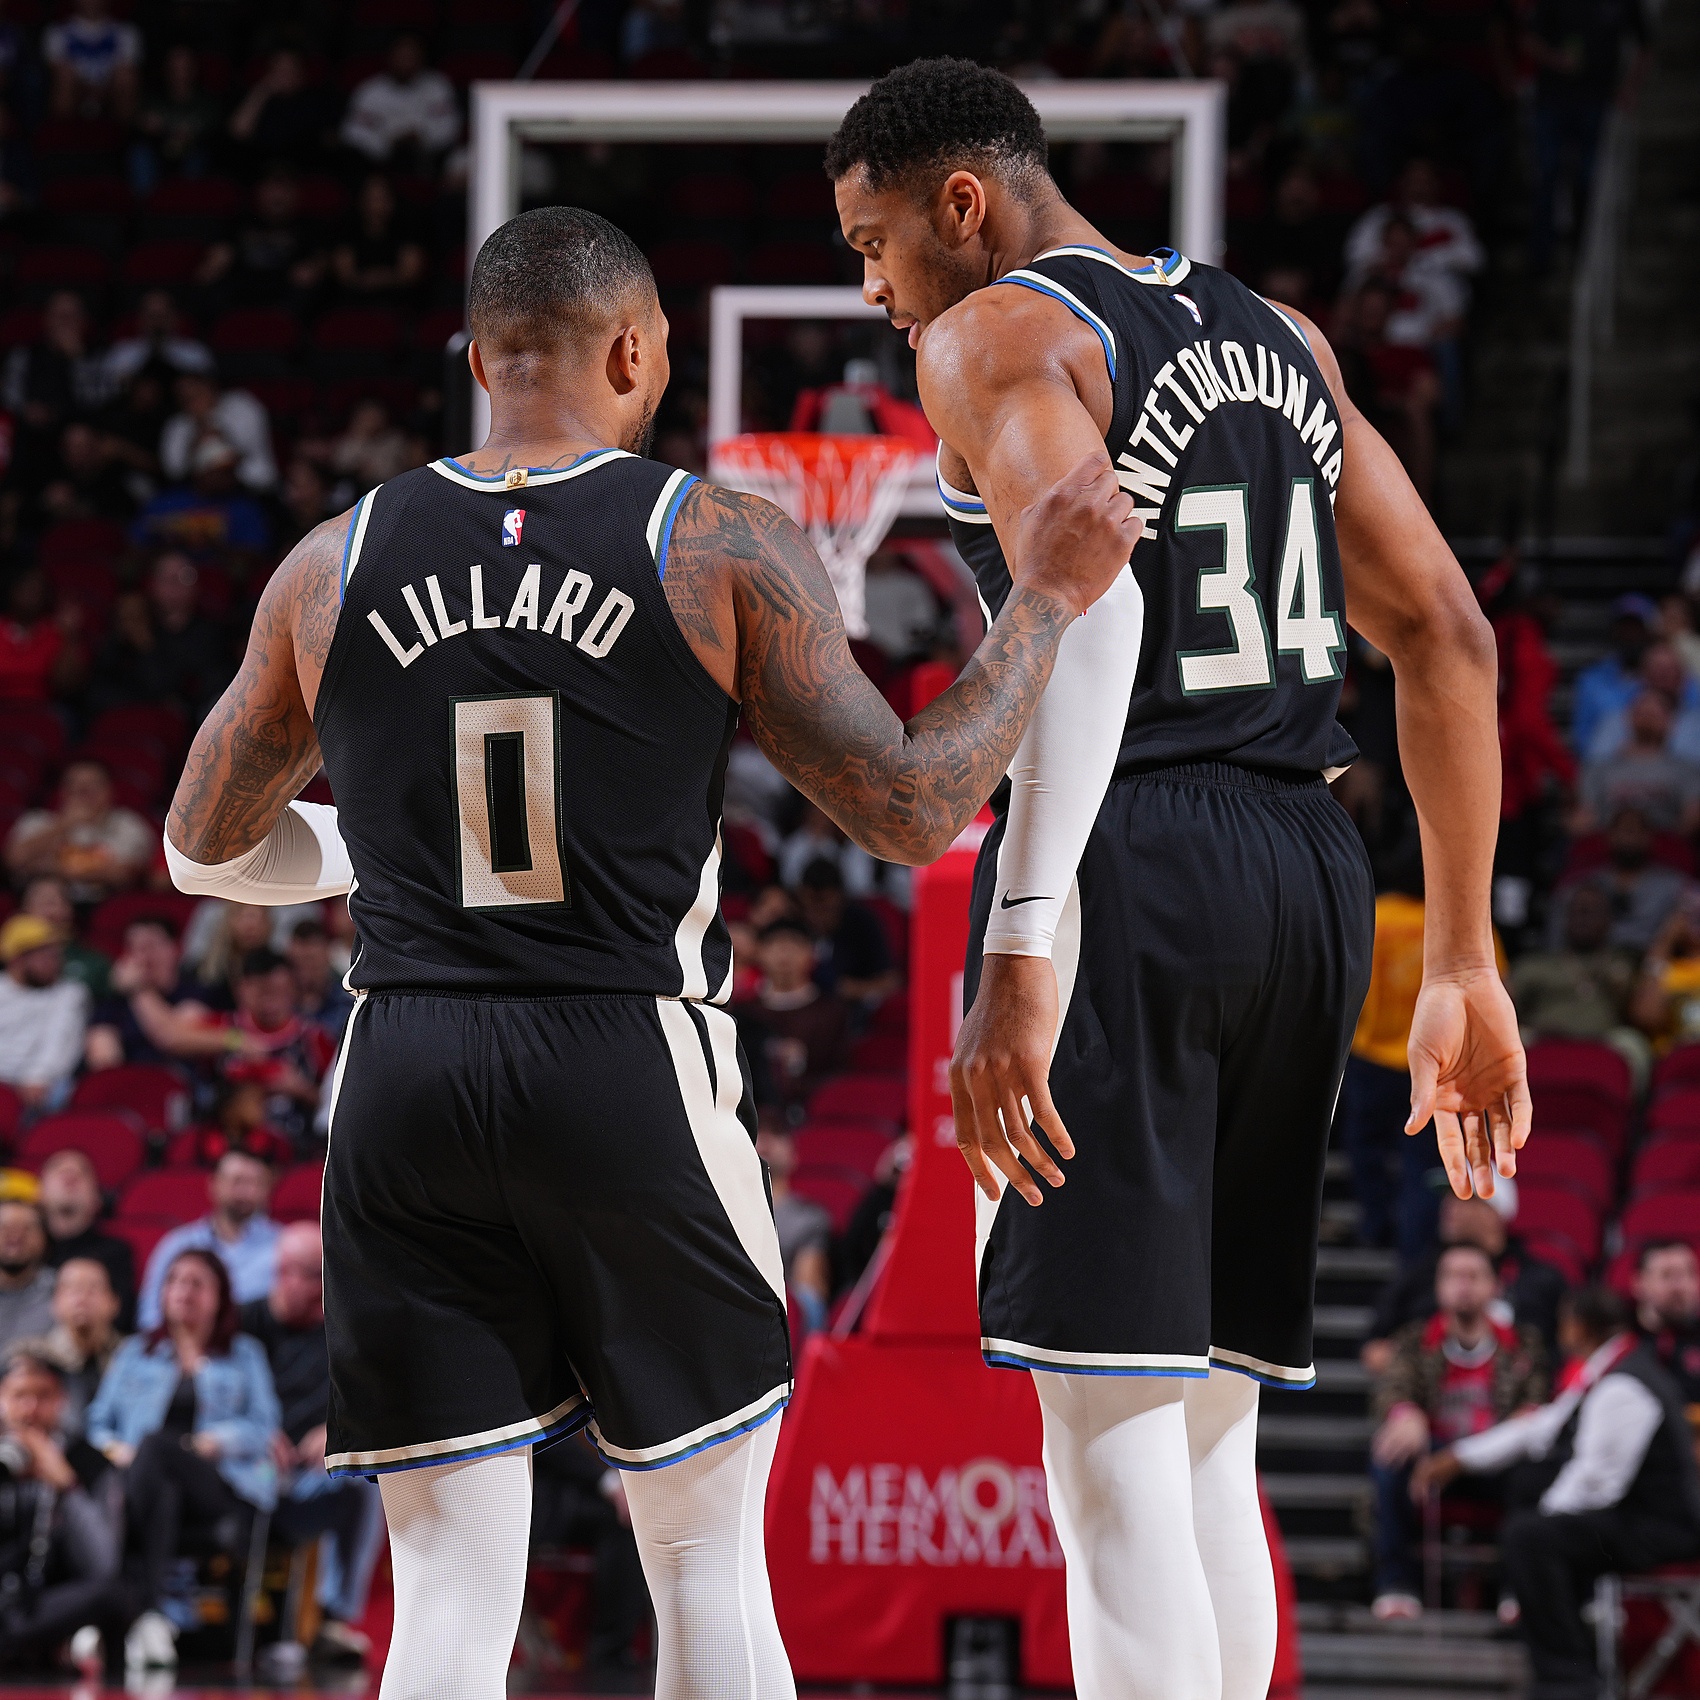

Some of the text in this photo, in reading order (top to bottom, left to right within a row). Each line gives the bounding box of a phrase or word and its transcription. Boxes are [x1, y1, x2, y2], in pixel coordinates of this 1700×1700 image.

[503, 536, 514, 546] NBA
[1174, 476, 1347, 697] 34
[366, 563, 635, 669] LILLARD
[448, 689, 572, 912] 0
[810, 1500, 1067, 1569] HERMA
